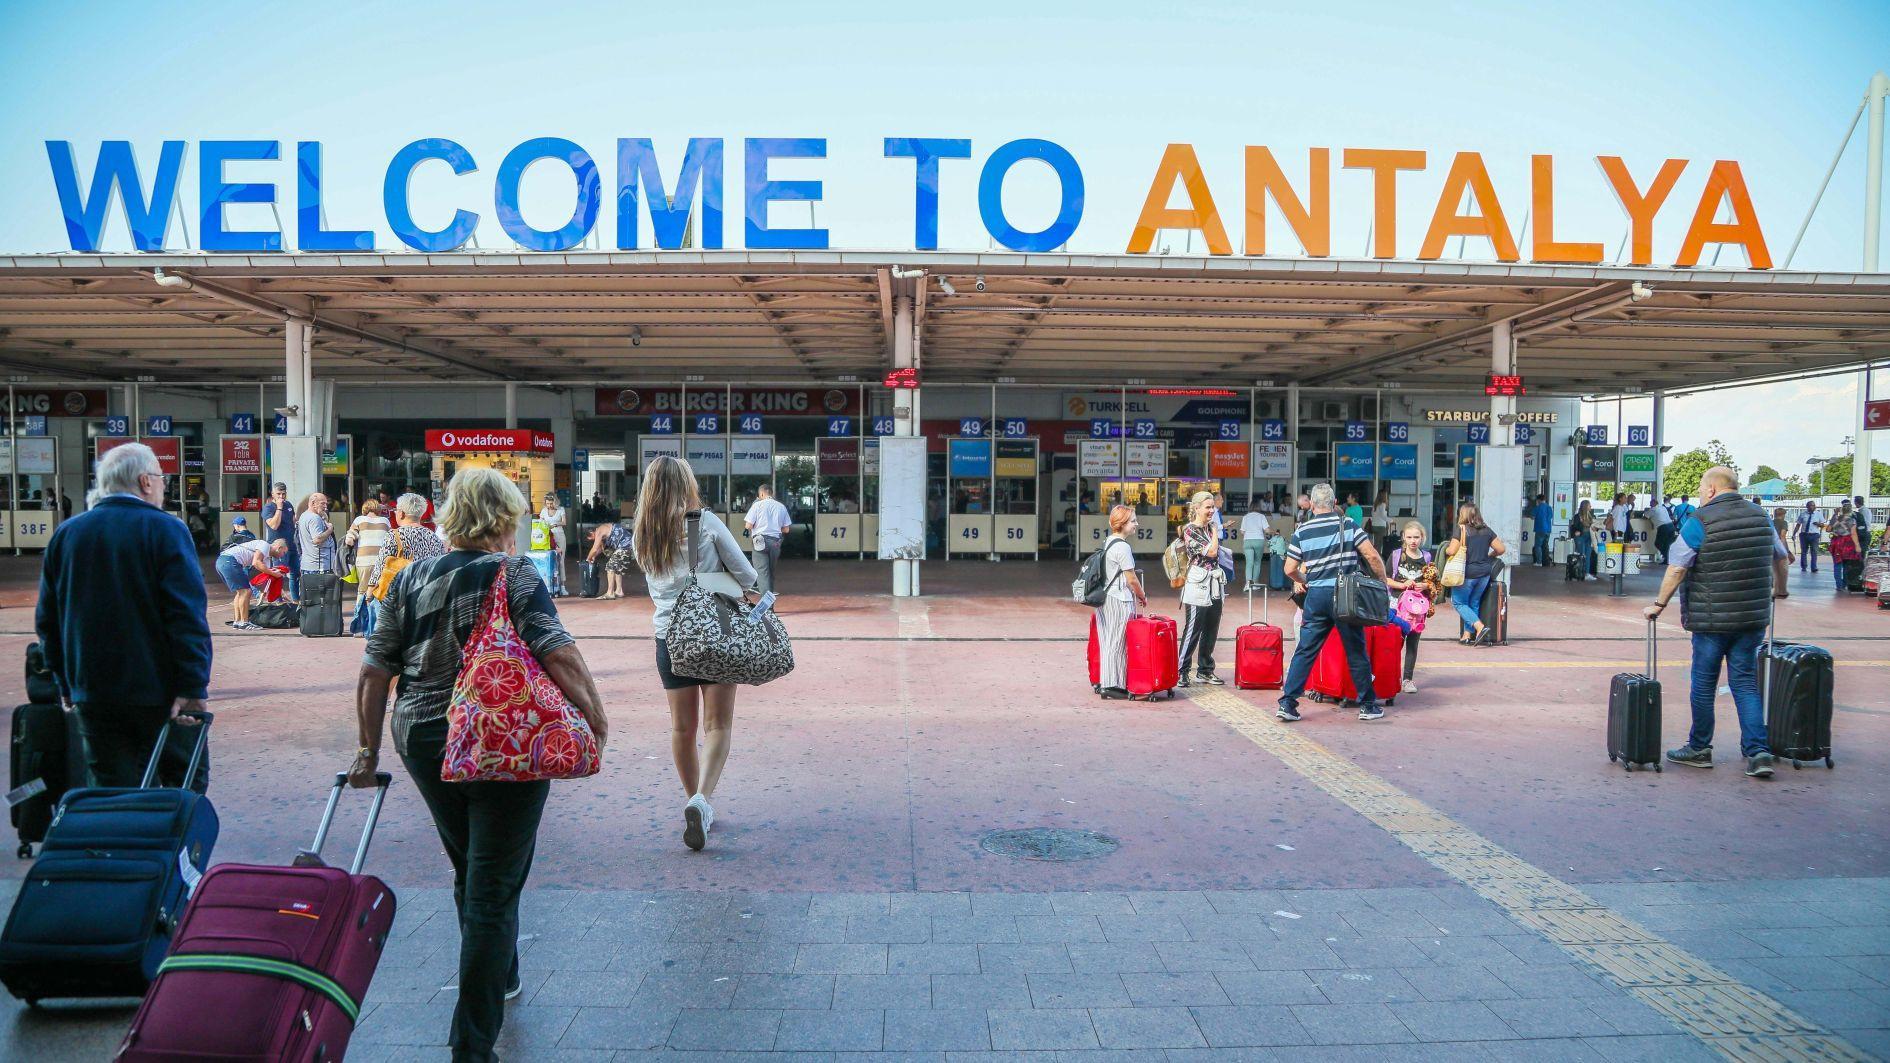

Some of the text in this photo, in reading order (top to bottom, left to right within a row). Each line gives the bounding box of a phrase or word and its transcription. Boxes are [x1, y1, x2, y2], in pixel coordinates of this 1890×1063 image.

[45, 137, 1772, 269] WELCOME TO ANTALYA
[0, 394, 50, 412] KNG
[655, 392, 808, 411] BURGER KING
[1427, 410, 1558, 423] STARBUC OFFEE
[26, 421, 44, 431] 38F
[108, 420, 126, 432] 39
[151, 420, 169, 432] 40
[234, 418, 251, 431] 41
[277, 418, 287, 431] 4
[652, 418, 672, 431] 44
[698, 418, 717, 431] 45
[742, 418, 761, 431] 46
[829, 420, 849, 434] 47
[875, 420, 893, 434] 48
[961, 421, 980, 434] 49
[1007, 422, 1025, 434] 50
[1093, 422, 1111, 435] 51
[1136, 422, 1154, 436] 52
[1221, 423, 1238, 437] 53
[1264, 426, 1282, 437] 54
[1347, 426, 1365, 438] 55
[1390, 426, 1407, 439] 56
[1470, 427, 1487, 440] 57
[1591, 428, 1606, 441] 59
[1631, 429, 1647, 442] 60
[458, 434, 514, 446] vodafone
[538, 437, 553, 448] vodafone
[234, 450, 249, 459] TOUR
[749, 452, 768, 460] PEGAS
[1352, 457, 1372, 465] Coral
[21, 523, 47, 535] 38F
[831, 527, 846, 539] 47
[963, 527, 979, 539] 49
[1007, 528, 1024, 539] 50
[1093, 529, 1109, 539] 51
[1138, 529, 1153, 540] 52
